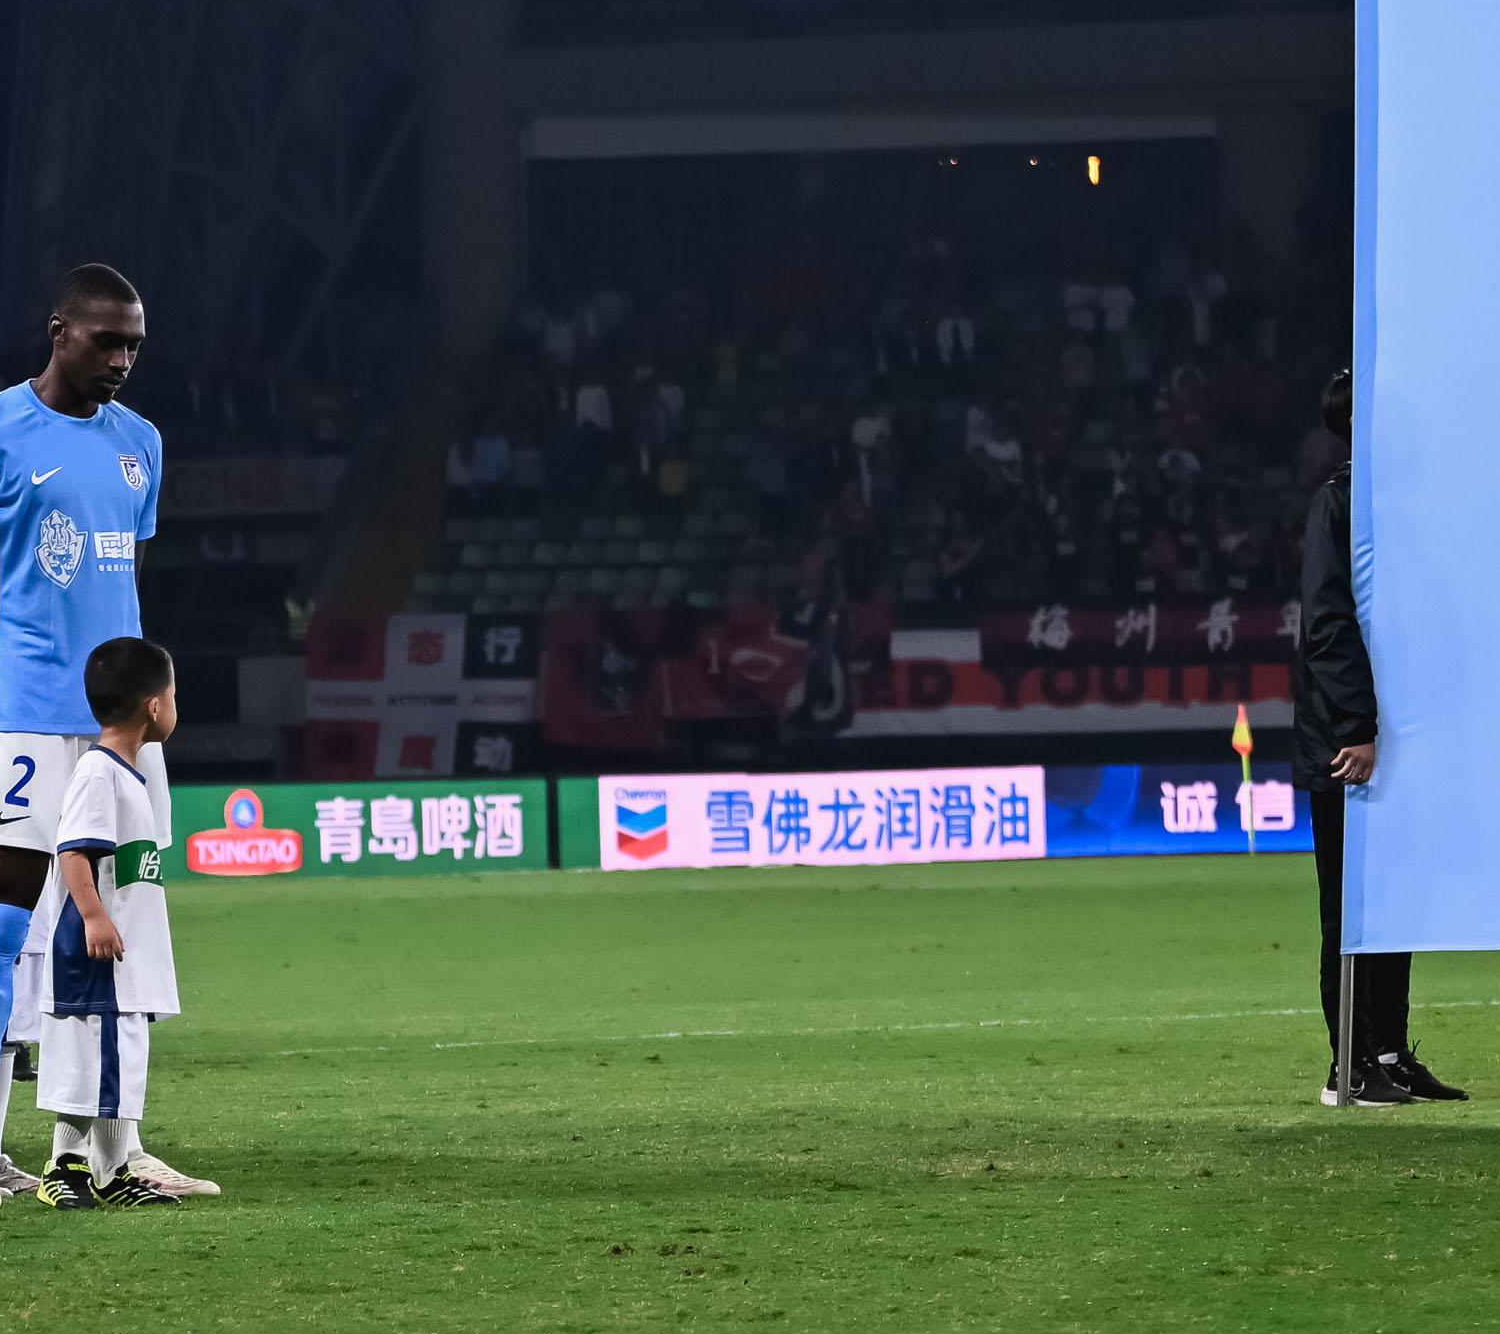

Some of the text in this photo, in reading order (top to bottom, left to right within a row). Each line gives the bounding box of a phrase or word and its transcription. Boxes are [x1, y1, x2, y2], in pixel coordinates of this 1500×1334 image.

[4, 755, 36, 807] 2
[1160, 780, 1296, 833] 诚信
[705, 782, 1031, 855] 雪佛龙润滑油
[193, 839, 298, 865] TSINGTAO
